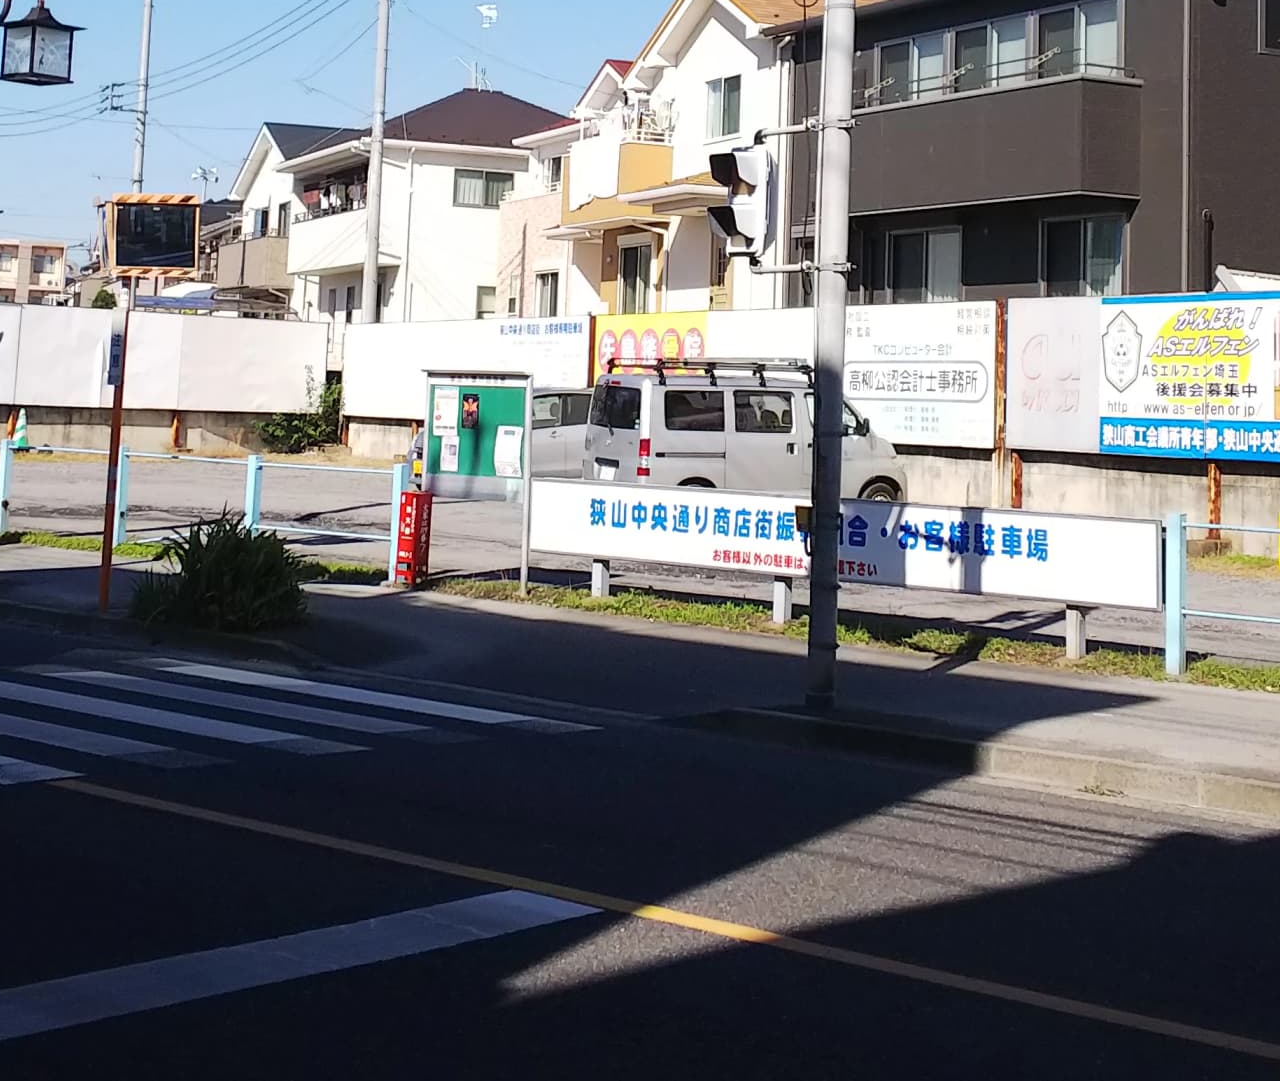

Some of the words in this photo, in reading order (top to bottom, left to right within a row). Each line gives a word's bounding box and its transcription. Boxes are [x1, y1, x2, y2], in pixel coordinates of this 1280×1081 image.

[1147, 336, 1261, 358] ASエルフェン
[849, 370, 978, 394] 高柳公認会計士事務所
[1142, 364, 1239, 379] ASエルフェン埼玉
[1156, 381, 1259, 399] 後援会募集中
[590, 497, 1049, 562] 狭山中央通り商店街振合・お客様駐車場
